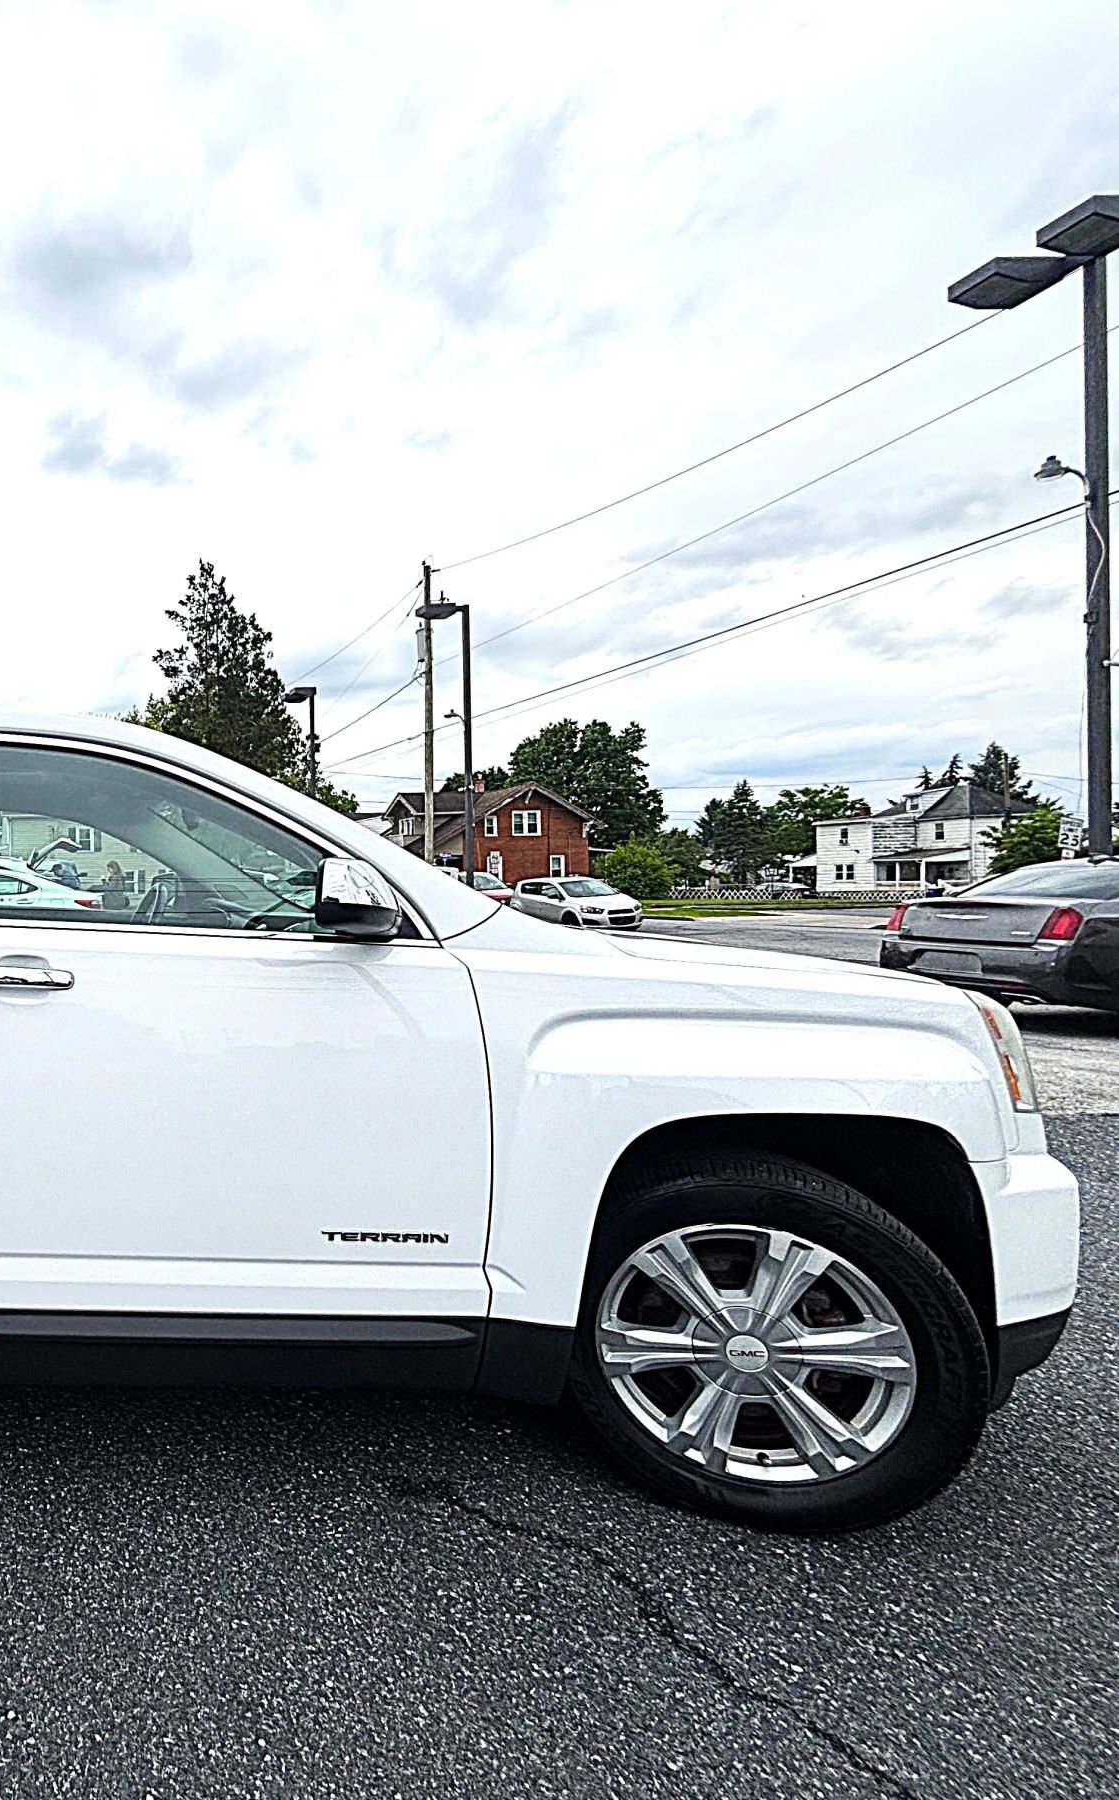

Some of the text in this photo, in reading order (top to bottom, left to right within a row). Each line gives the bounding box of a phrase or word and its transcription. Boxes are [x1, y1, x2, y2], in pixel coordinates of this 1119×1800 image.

[1059, 832, 1080, 847] 25
[320, 1230, 449, 1244] TERRAIN
[729, 1349, 766, 1358] GMC
